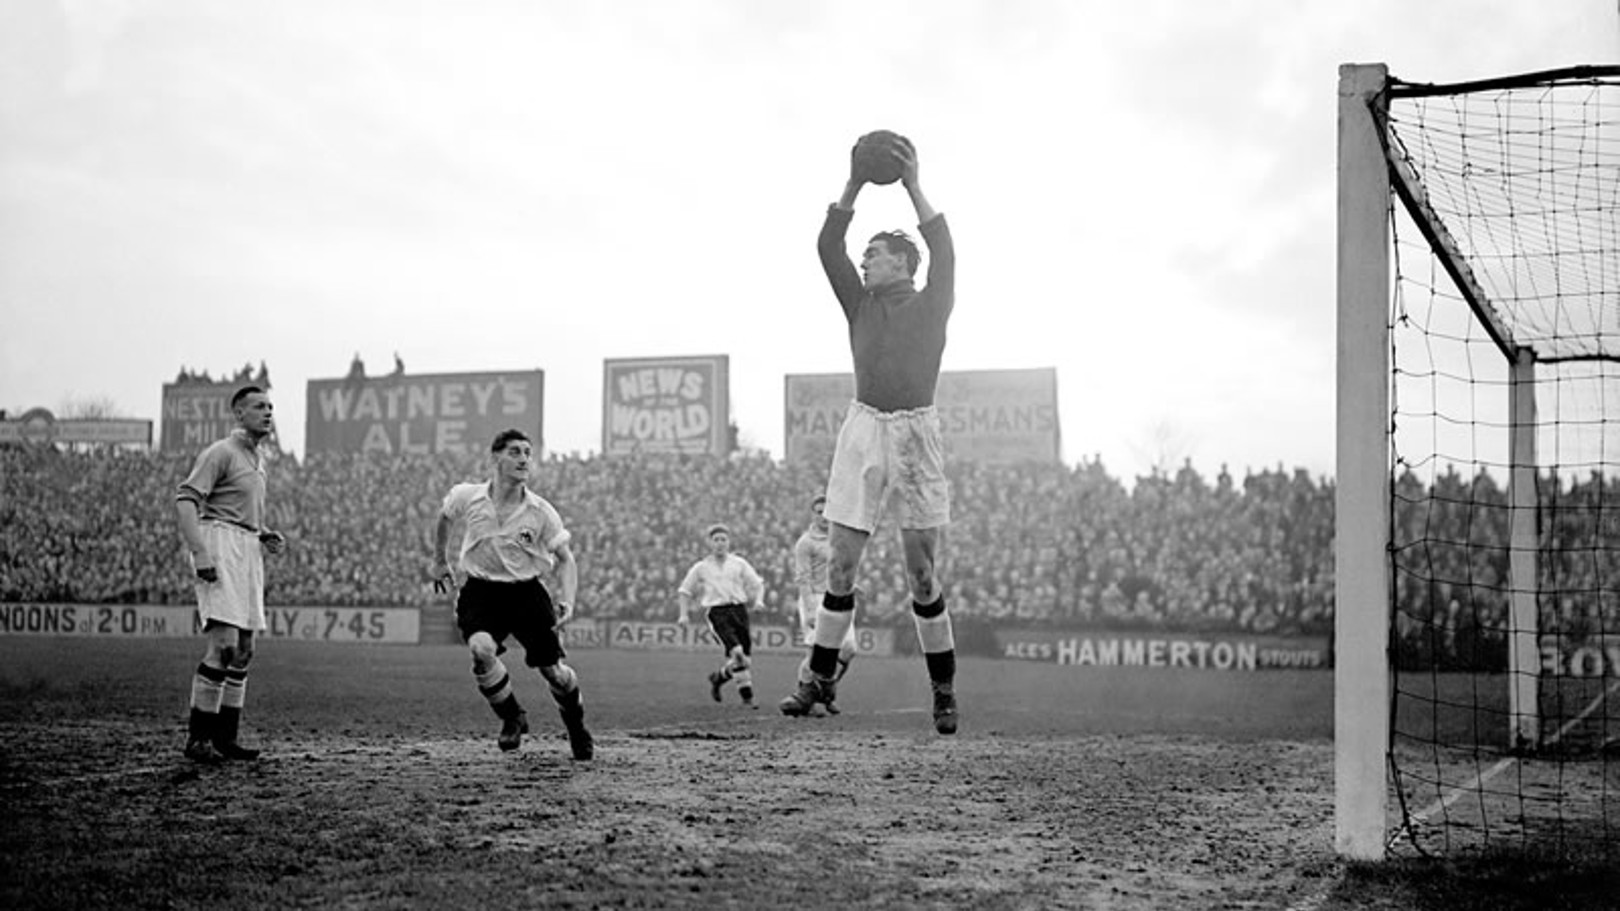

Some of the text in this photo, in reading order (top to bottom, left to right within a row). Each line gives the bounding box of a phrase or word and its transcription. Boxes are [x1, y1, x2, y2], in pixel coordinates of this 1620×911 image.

[318, 377, 528, 422] WATNEY'S
[618, 368, 704, 401] NEWS
[163, 396, 233, 420] NESTL
[611, 402, 709, 439] WORLD
[937, 405, 1054, 433] SSMANS
[183, 421, 231, 445] MIL
[1057, 638, 1257, 671] HAMMERTON
